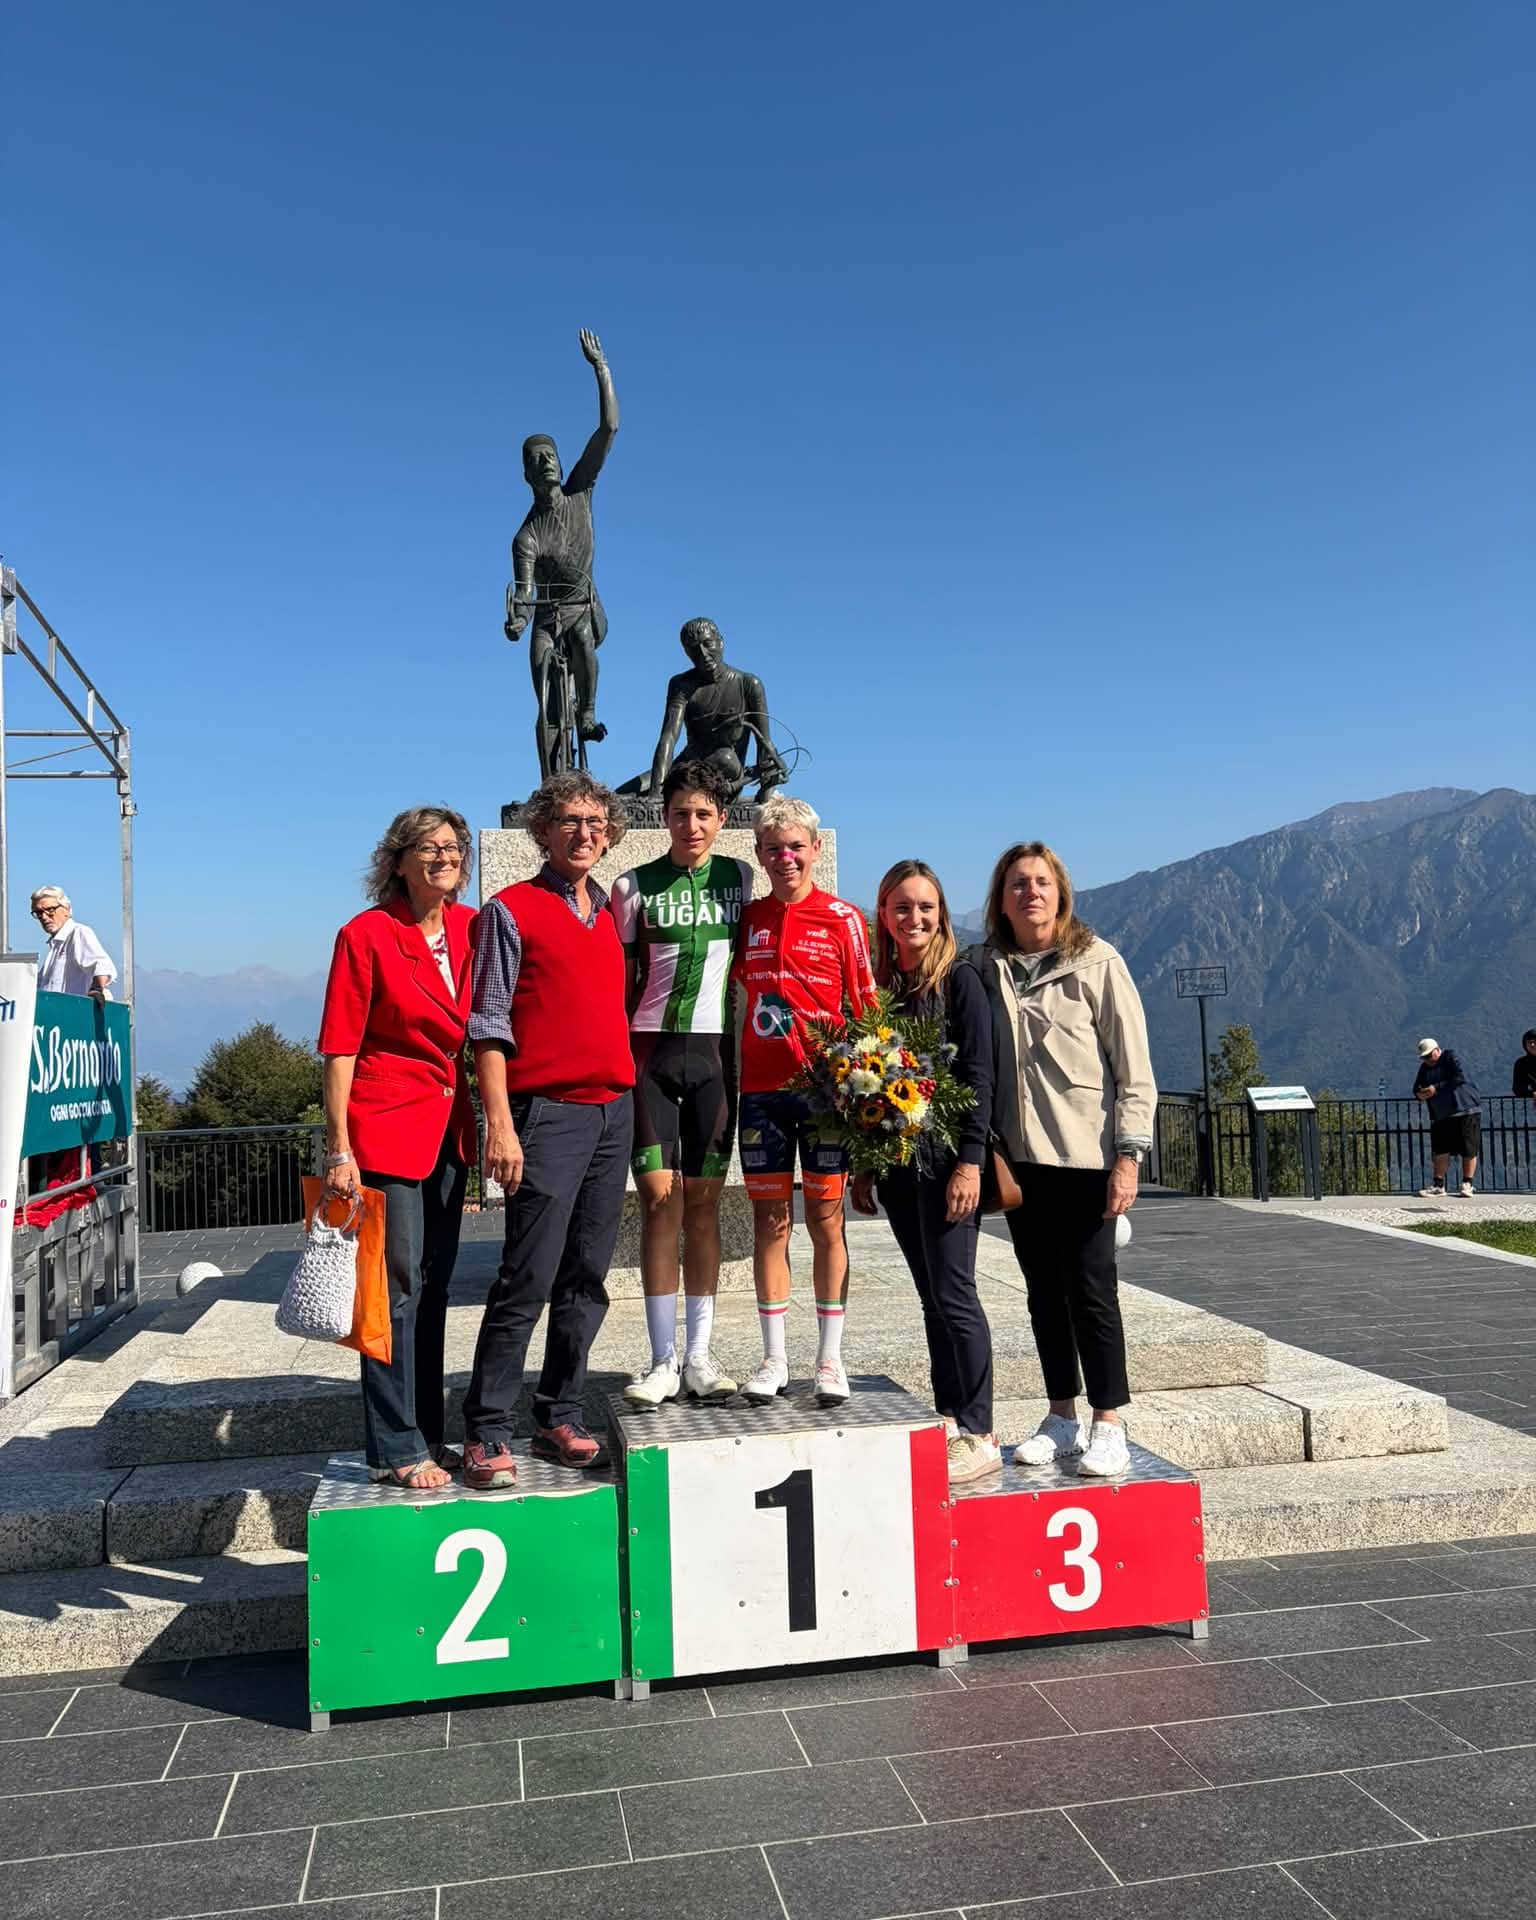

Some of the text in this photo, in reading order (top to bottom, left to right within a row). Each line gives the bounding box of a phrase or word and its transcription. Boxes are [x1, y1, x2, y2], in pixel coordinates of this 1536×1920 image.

[642, 902, 741, 929] LUGANO
[643, 887, 741, 908] VELO CLUB
[50, 1104, 69, 1122] OGNI
[755, 1469, 819, 1634] 1
[1046, 1506, 1104, 1613] 3
[434, 1528, 510, 1665] 2
